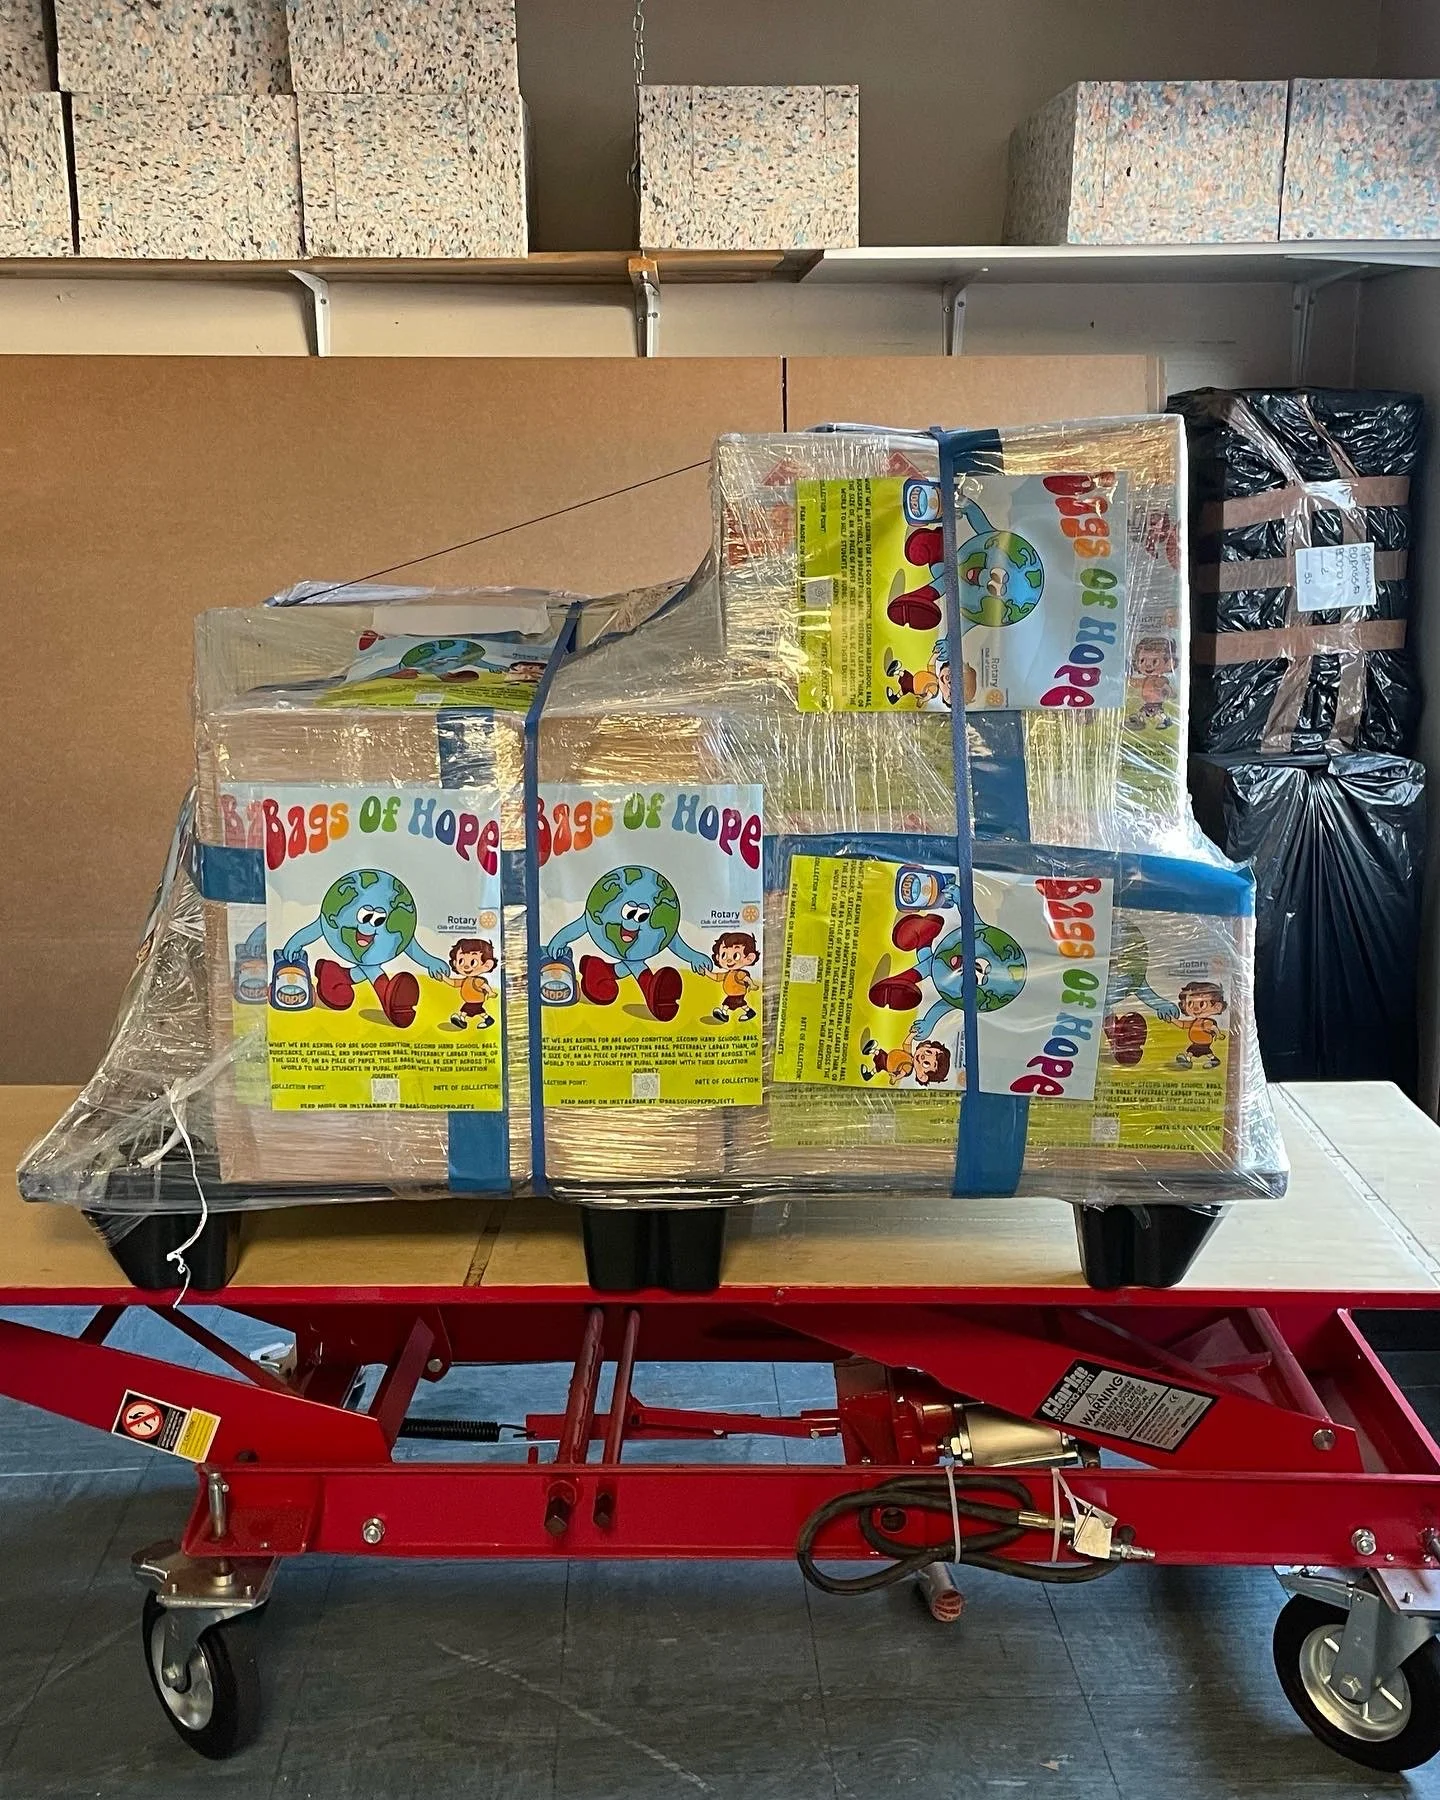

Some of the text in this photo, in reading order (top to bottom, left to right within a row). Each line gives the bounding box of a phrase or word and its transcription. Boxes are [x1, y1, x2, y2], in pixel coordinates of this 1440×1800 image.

[1080, 568, 1118, 609] Of
[990, 658, 1000, 687] Rotary
[1040, 616, 1117, 708] Hope
[263, 795, 499, 876] Bags Of Hope
[537, 792, 762, 870] Bags Of Hope
[448, 916, 477, 925] Rotary
[711, 910, 740, 919] Rotary
[1010, 878, 1102, 1096] Bags Of Hope
[1042, 1366, 1089, 1418] Clarke
[1080, 1375, 1123, 1426] WARNING
